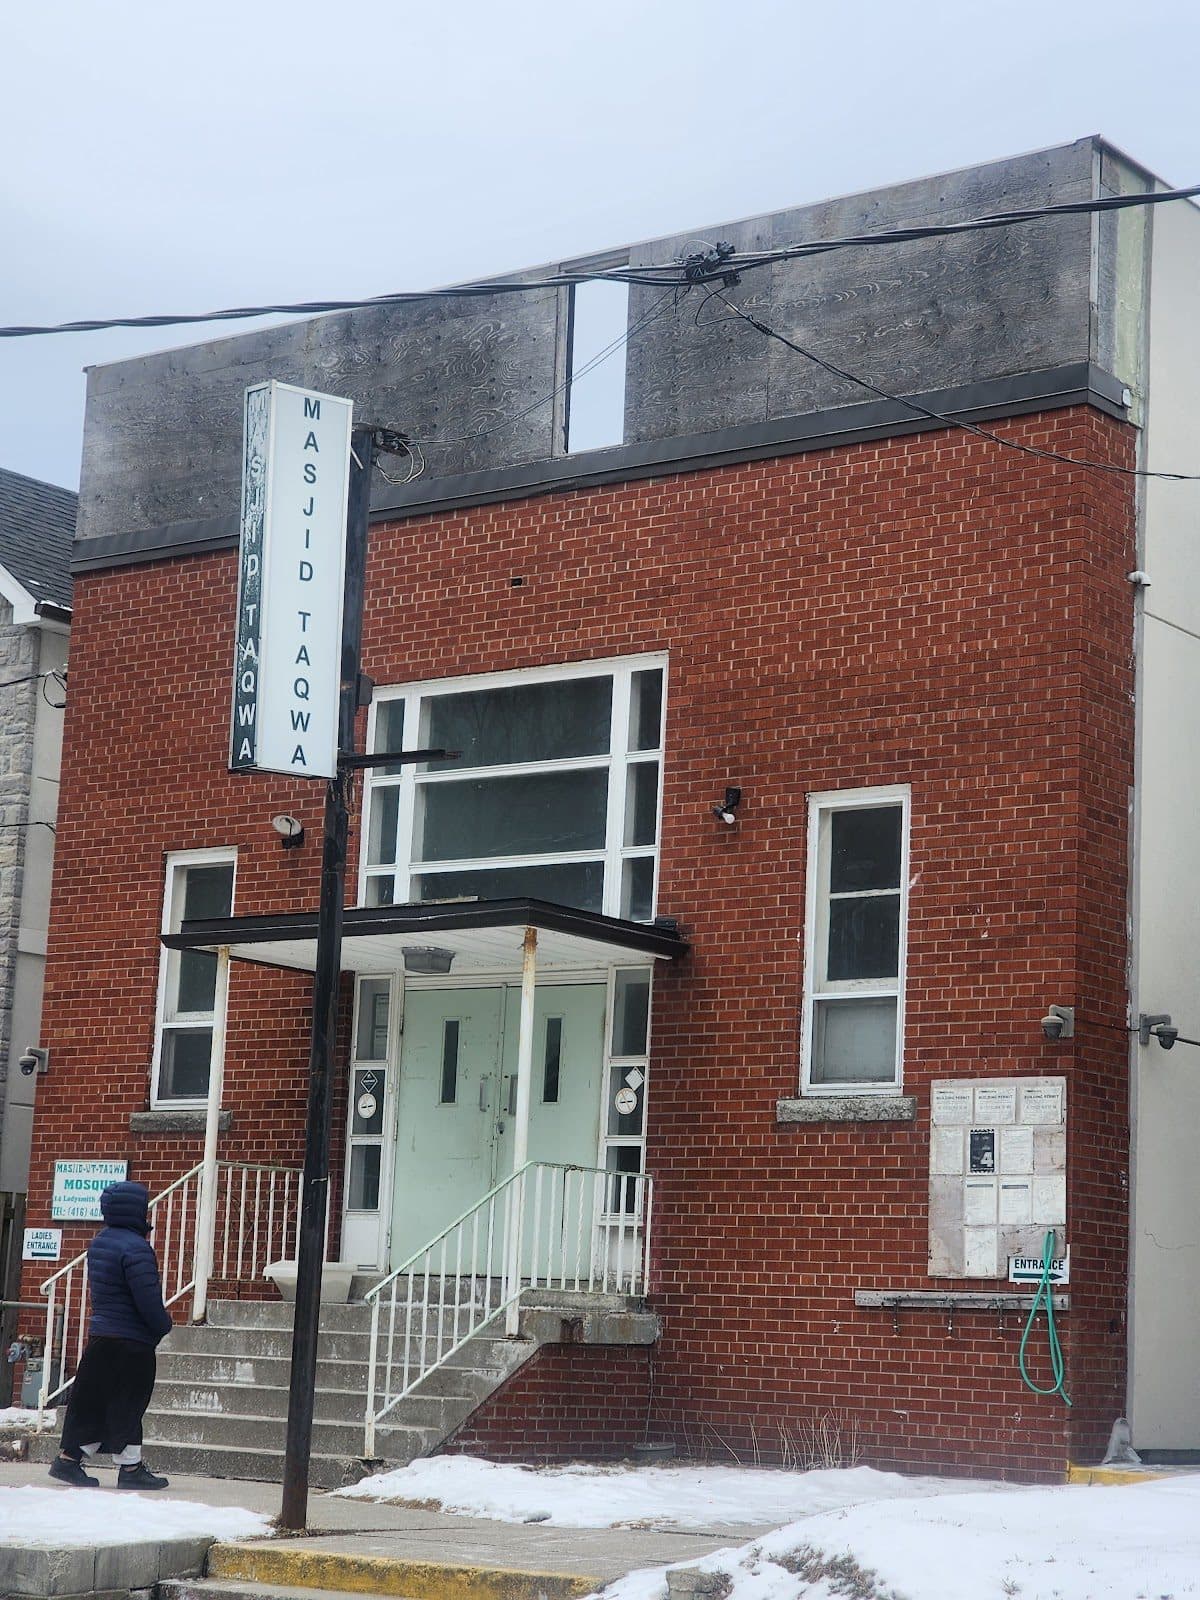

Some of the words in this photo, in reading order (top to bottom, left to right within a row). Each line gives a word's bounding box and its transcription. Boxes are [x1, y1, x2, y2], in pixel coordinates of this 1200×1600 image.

[299, 397, 321, 582] MASJID
[238, 603, 259, 761] TAQWA
[290, 610, 312, 767] TAQWA
[63, 1195, 96, 1203] Ladysmith
[68, 1206, 88, 1217] (416)
[31, 1231, 52, 1240] LADIES
[26, 1241, 57, 1250] ENTRANCE
